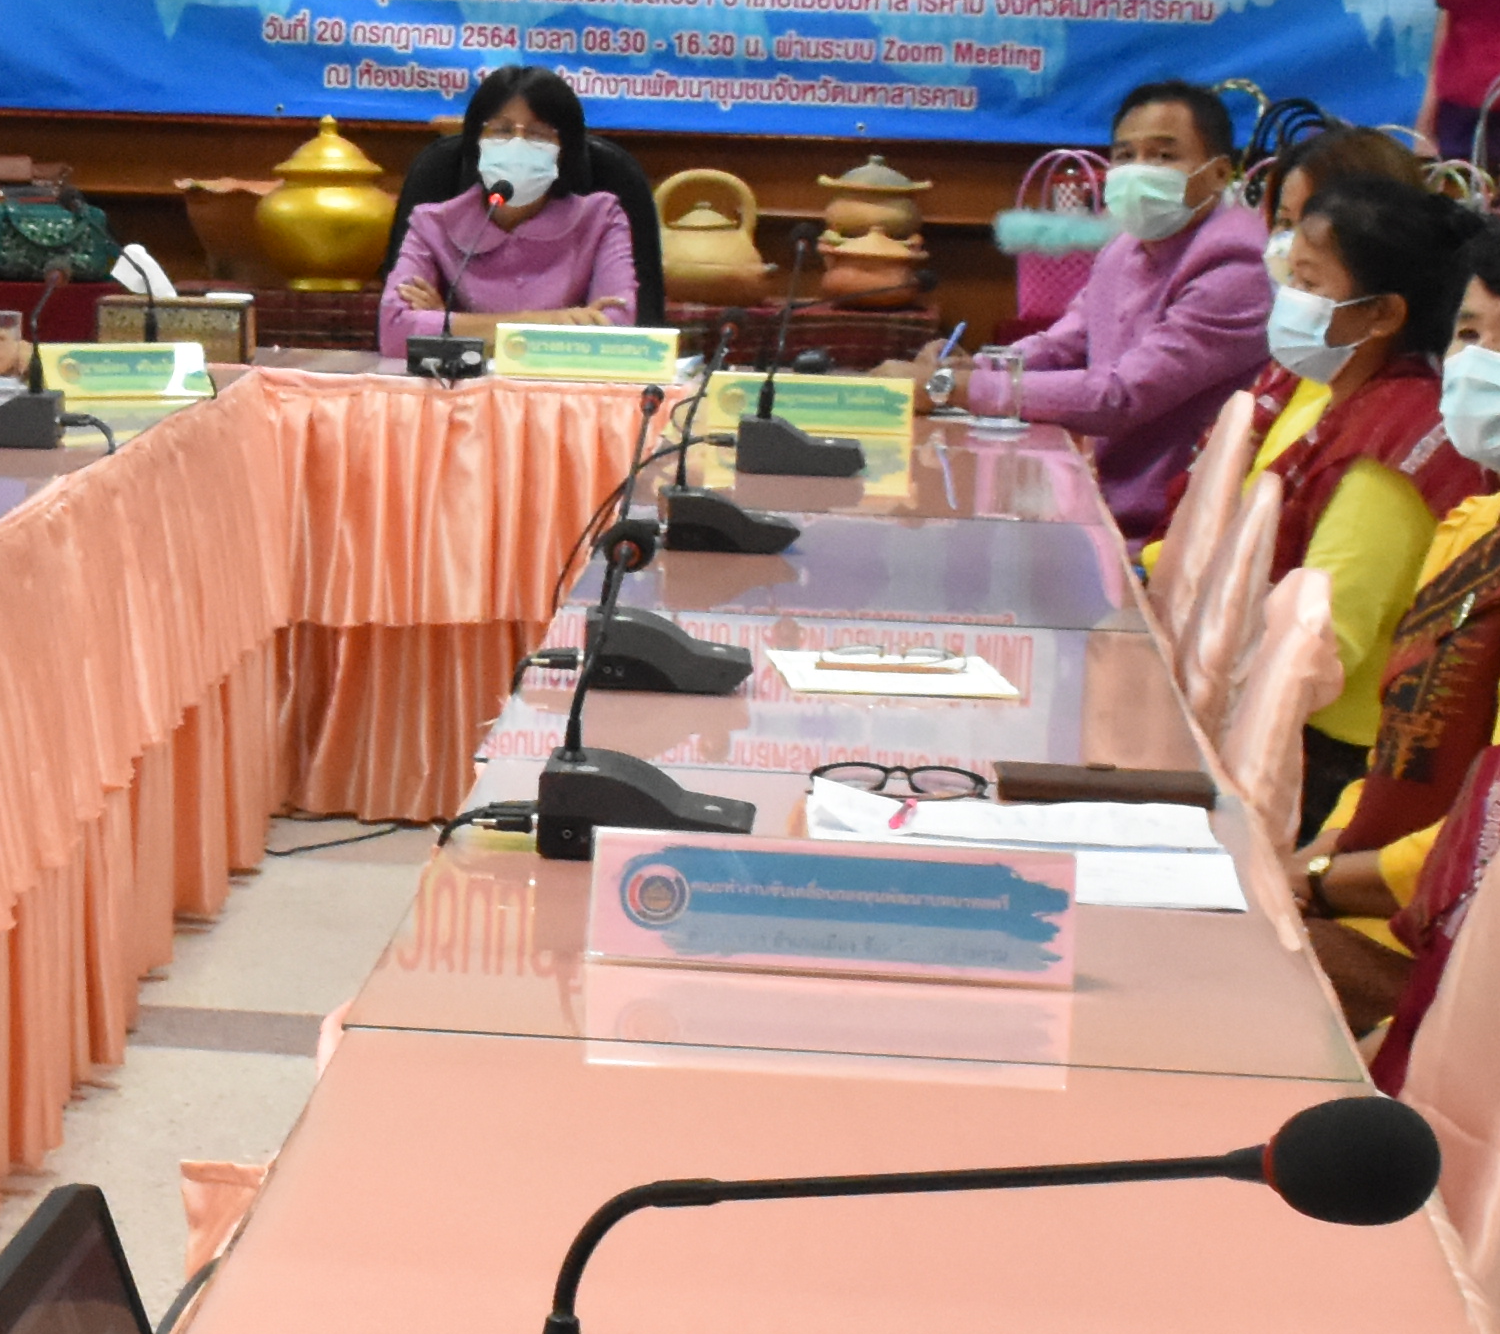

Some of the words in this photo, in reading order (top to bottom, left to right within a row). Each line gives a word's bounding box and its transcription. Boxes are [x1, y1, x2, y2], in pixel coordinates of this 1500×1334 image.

[264, 16, 308, 43] วันที่
[316, 22, 344, 44] 20
[352, 22, 453, 53] กรกฎาคม
[462, 25, 519, 49] 2564
[527, 28, 576, 51] เวลา
[583, 30, 646, 54] 08.30
[674, 33, 735, 58] 16.30
[745, 37, 766, 58] น.
[775, 30, 875, 61] ผ่านระบบ
[882, 39, 943, 64] Zoom
[954, 43, 1043, 71] Meeting
[325, 65, 350, 88] ณ
[358, 59, 468, 98] ห้องประชุม
